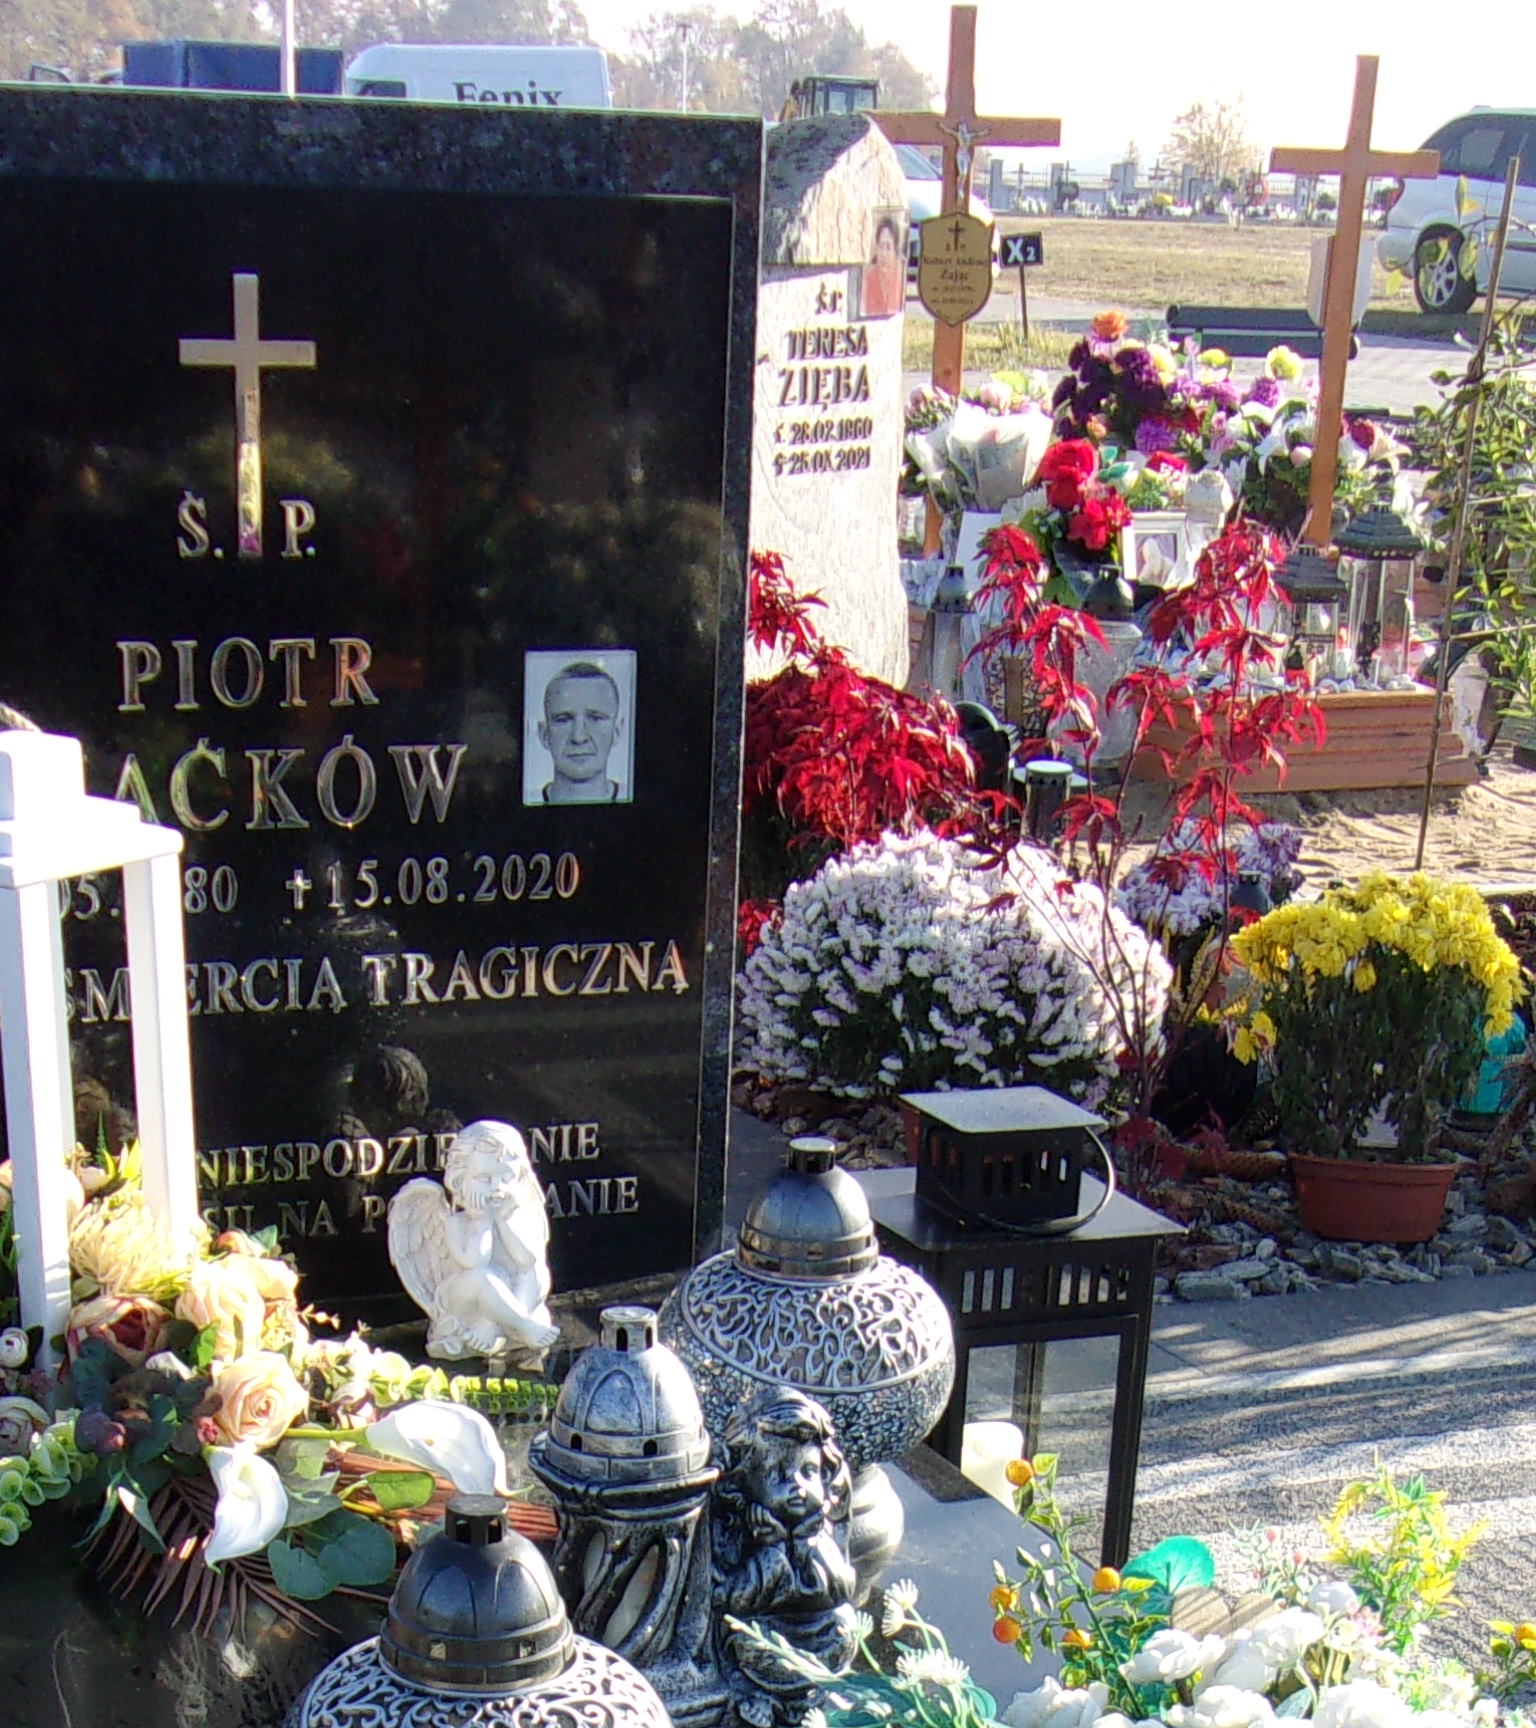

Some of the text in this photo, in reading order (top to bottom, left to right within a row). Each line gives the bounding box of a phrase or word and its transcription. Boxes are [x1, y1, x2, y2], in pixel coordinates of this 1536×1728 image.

[452, 80, 563, 106] Fenix
[785, 325, 869, 361] TERESA
[778, 364, 872, 413] ZIĘBA
[177, 490, 316, 559] Ś. P.
[116, 636, 381, 713] PIOTR
[114, 734, 469, 832] AĆKÓW
[327, 851, 582, 909] 15.08.2020
[62, 956, 349, 1025] MERCIĄ
[361, 938, 691, 1010] TRAGICZNĄ
[195, 1121, 601, 1191] NIESPODZIENIE
[279, 1199, 340, 1241] NA
